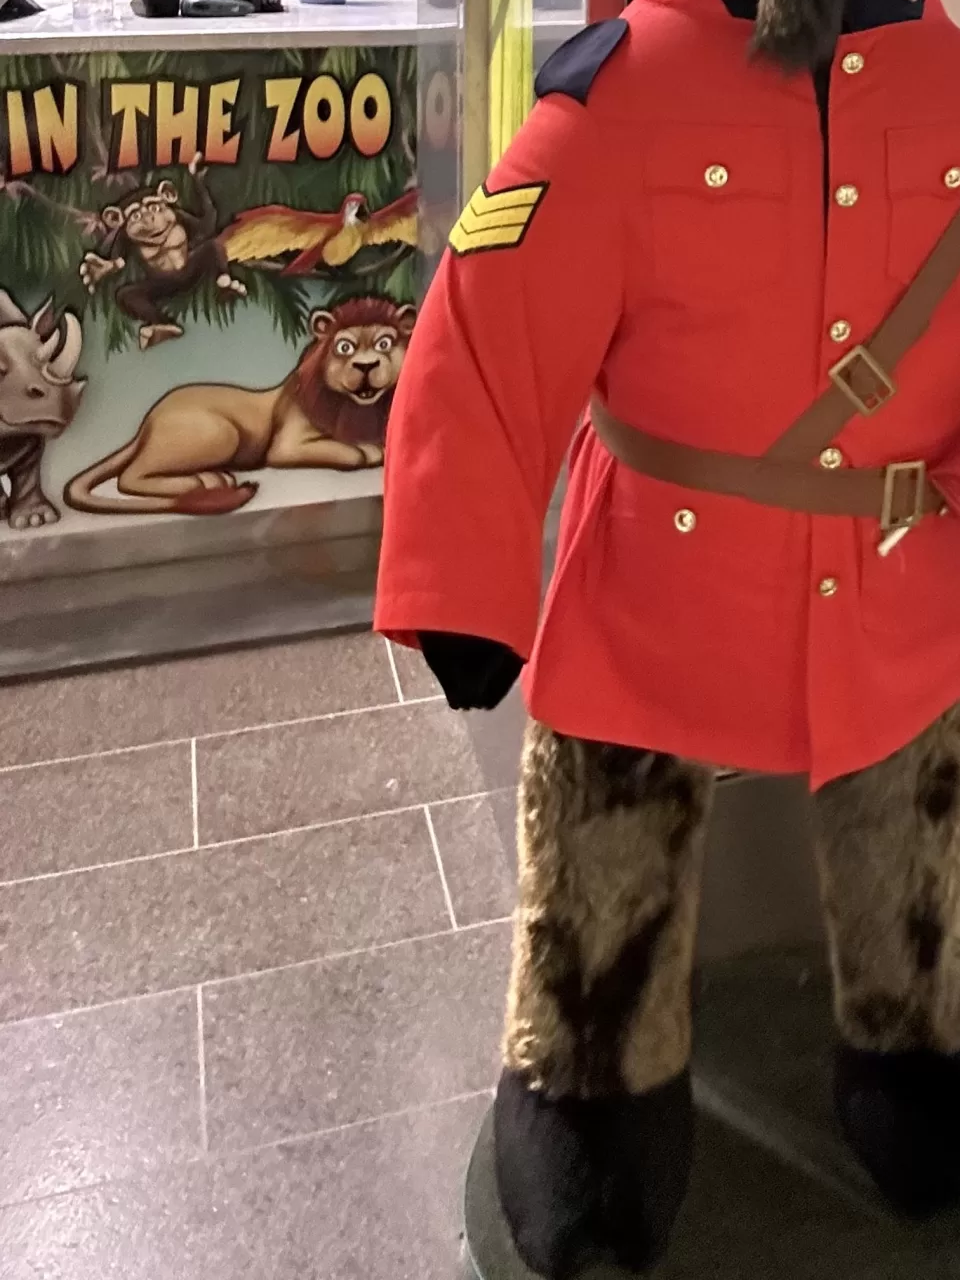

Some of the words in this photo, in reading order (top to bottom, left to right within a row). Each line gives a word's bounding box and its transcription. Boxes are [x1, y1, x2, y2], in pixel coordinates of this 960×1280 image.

[6, 82, 79, 177] IN
[110, 77, 242, 170] THE
[264, 72, 392, 162] ZOO
